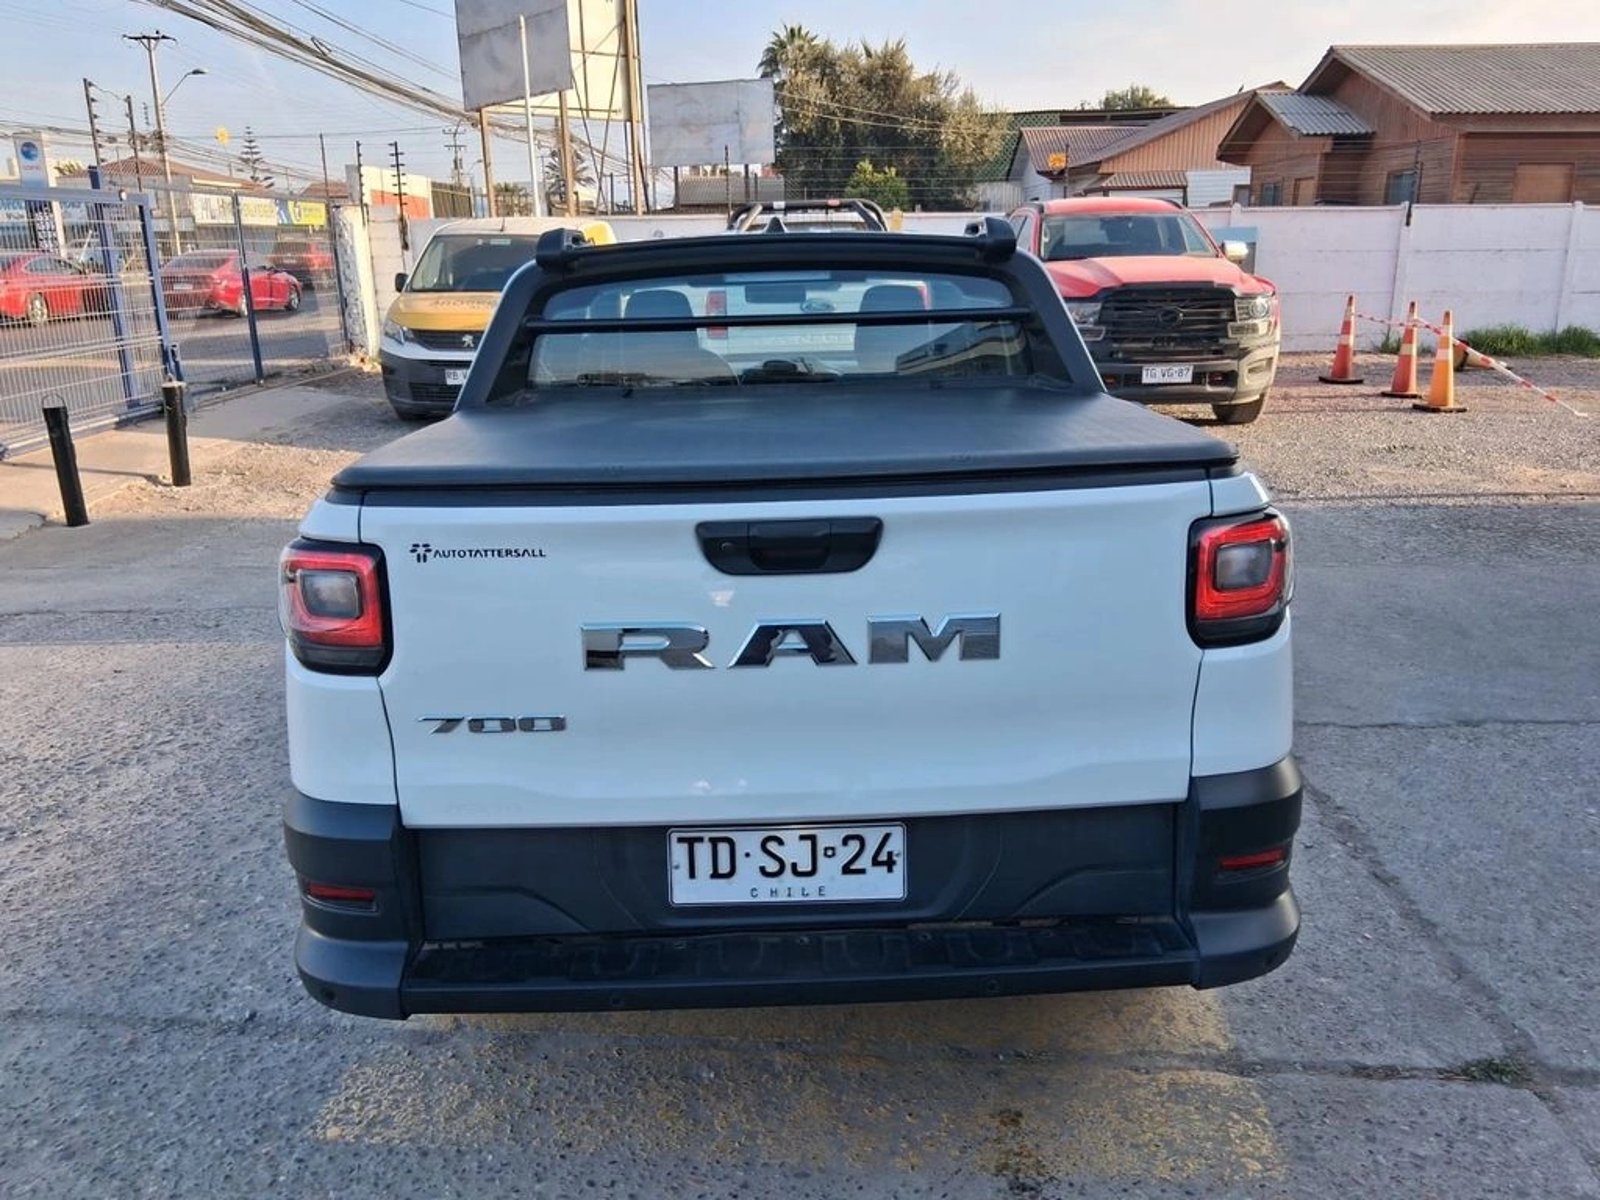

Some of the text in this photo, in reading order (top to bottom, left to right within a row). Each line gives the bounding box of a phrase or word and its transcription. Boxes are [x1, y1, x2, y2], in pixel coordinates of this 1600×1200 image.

[433, 549, 546, 559] AUTOTATTERSALL
[580, 612, 1001, 670] RAM
[418, 715, 566, 735] 700
[750, 886, 826, 898] CHILE
